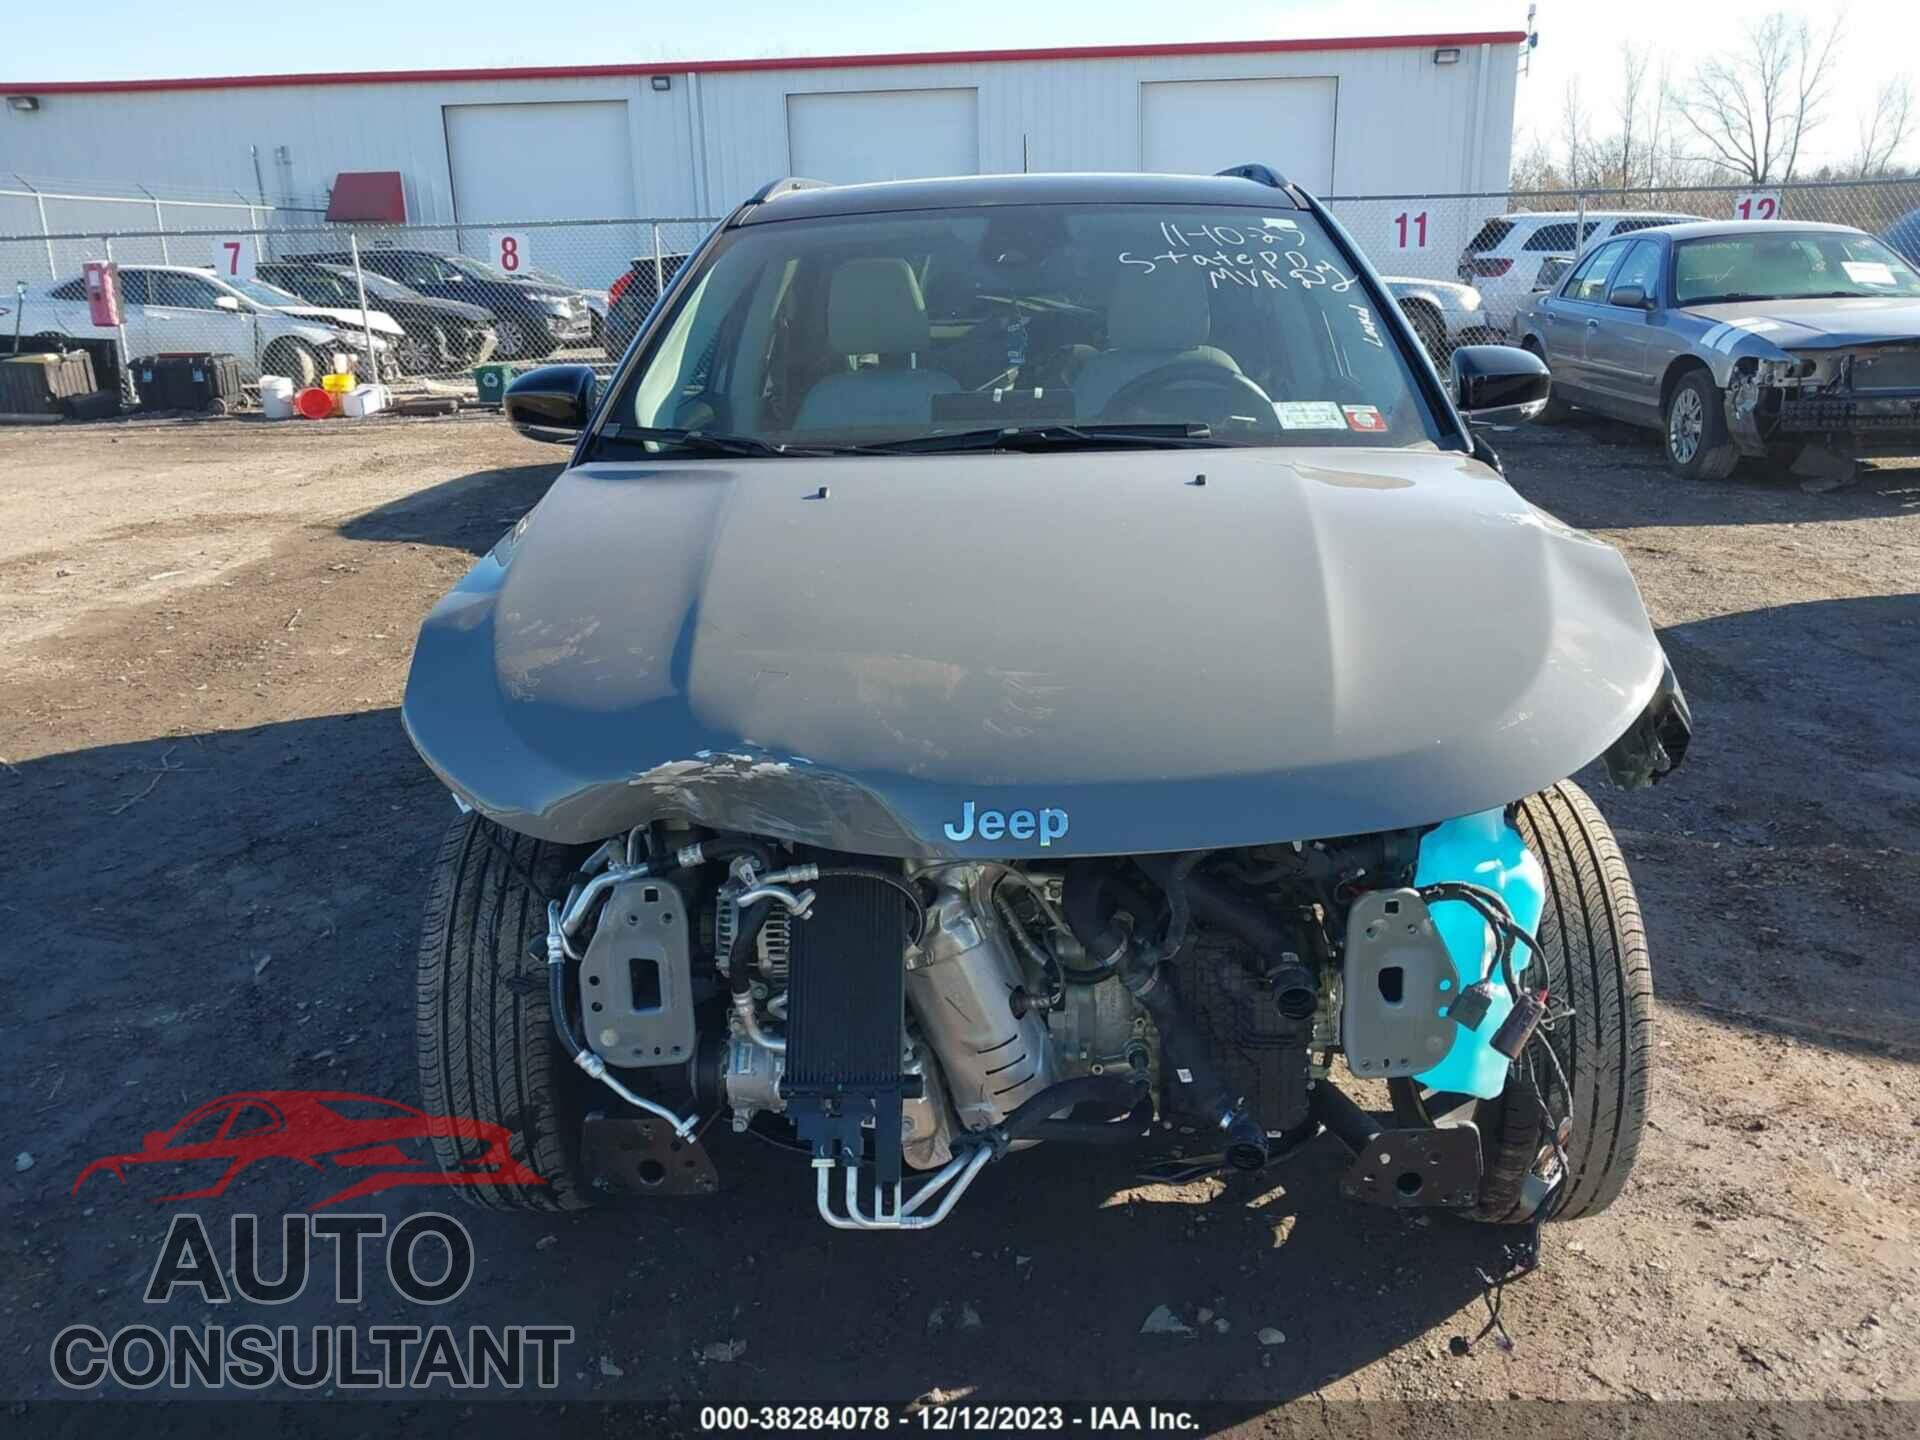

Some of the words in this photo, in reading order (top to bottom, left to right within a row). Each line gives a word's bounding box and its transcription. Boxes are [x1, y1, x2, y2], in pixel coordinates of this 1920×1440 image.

[1738, 197, 1776, 220] 12
[1395, 211, 1427, 248] 11
[223, 242, 241, 275] 7
[501, 236, 519, 271] 8
[1210, 266, 1289, 289] MVA
[943, 800, 1069, 848] Jeep
